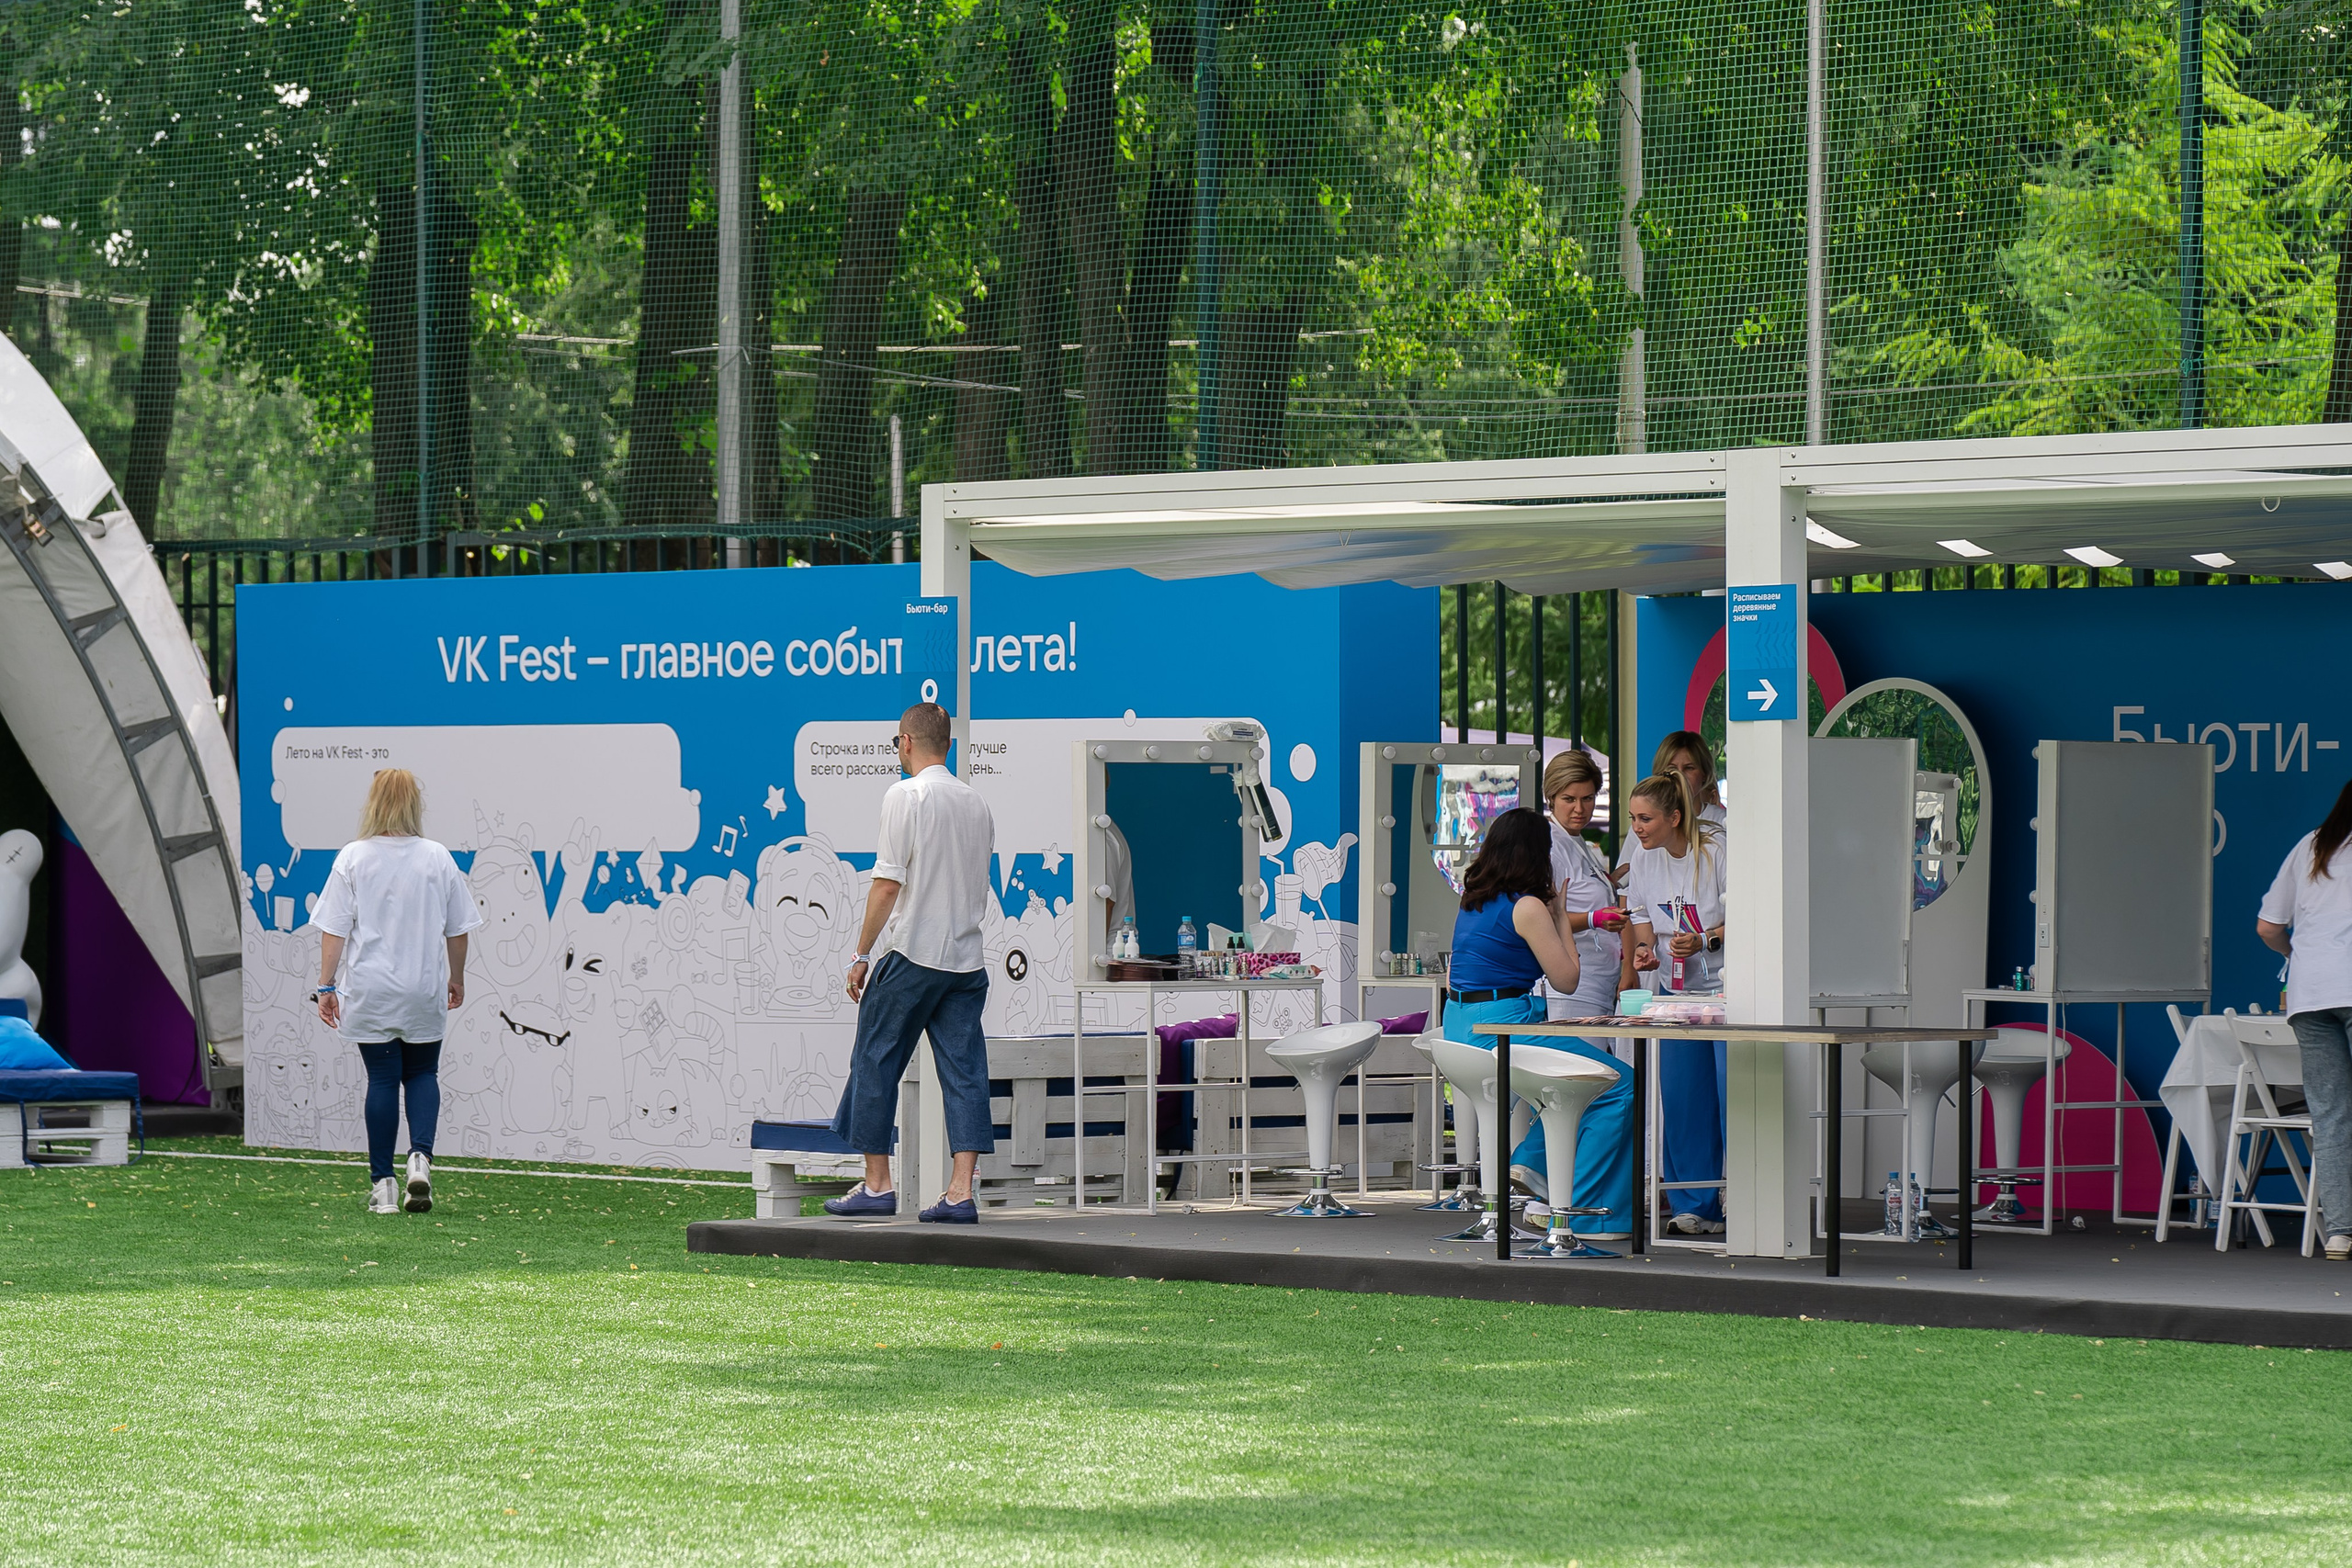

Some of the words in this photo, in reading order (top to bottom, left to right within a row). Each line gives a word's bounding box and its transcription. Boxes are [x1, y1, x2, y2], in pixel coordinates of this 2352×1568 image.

[1732, 593, 1781, 602] Расписываем
[906, 603, 948, 615] Бьюти-бар
[1732, 603, 1777, 614] деревянные
[437, 636, 490, 682] VK
[499, 635, 577, 682] Fest
[620, 640, 775, 679] главное
[785, 626, 903, 676] событ
[970, 621, 1077, 673] лета!
[285, 746, 311, 760] Лето
[311, 749, 324, 759] на
[325, 746, 340, 759] VK
[341, 746, 363, 759] Fest
[371, 748, 390, 759] это
[810, 741, 859, 759] Строчка
[862, 744, 875, 755] из
[969, 743, 1007, 758] лучше
[810, 764, 844, 776] всего
[846, 764, 901, 779] расскаже
